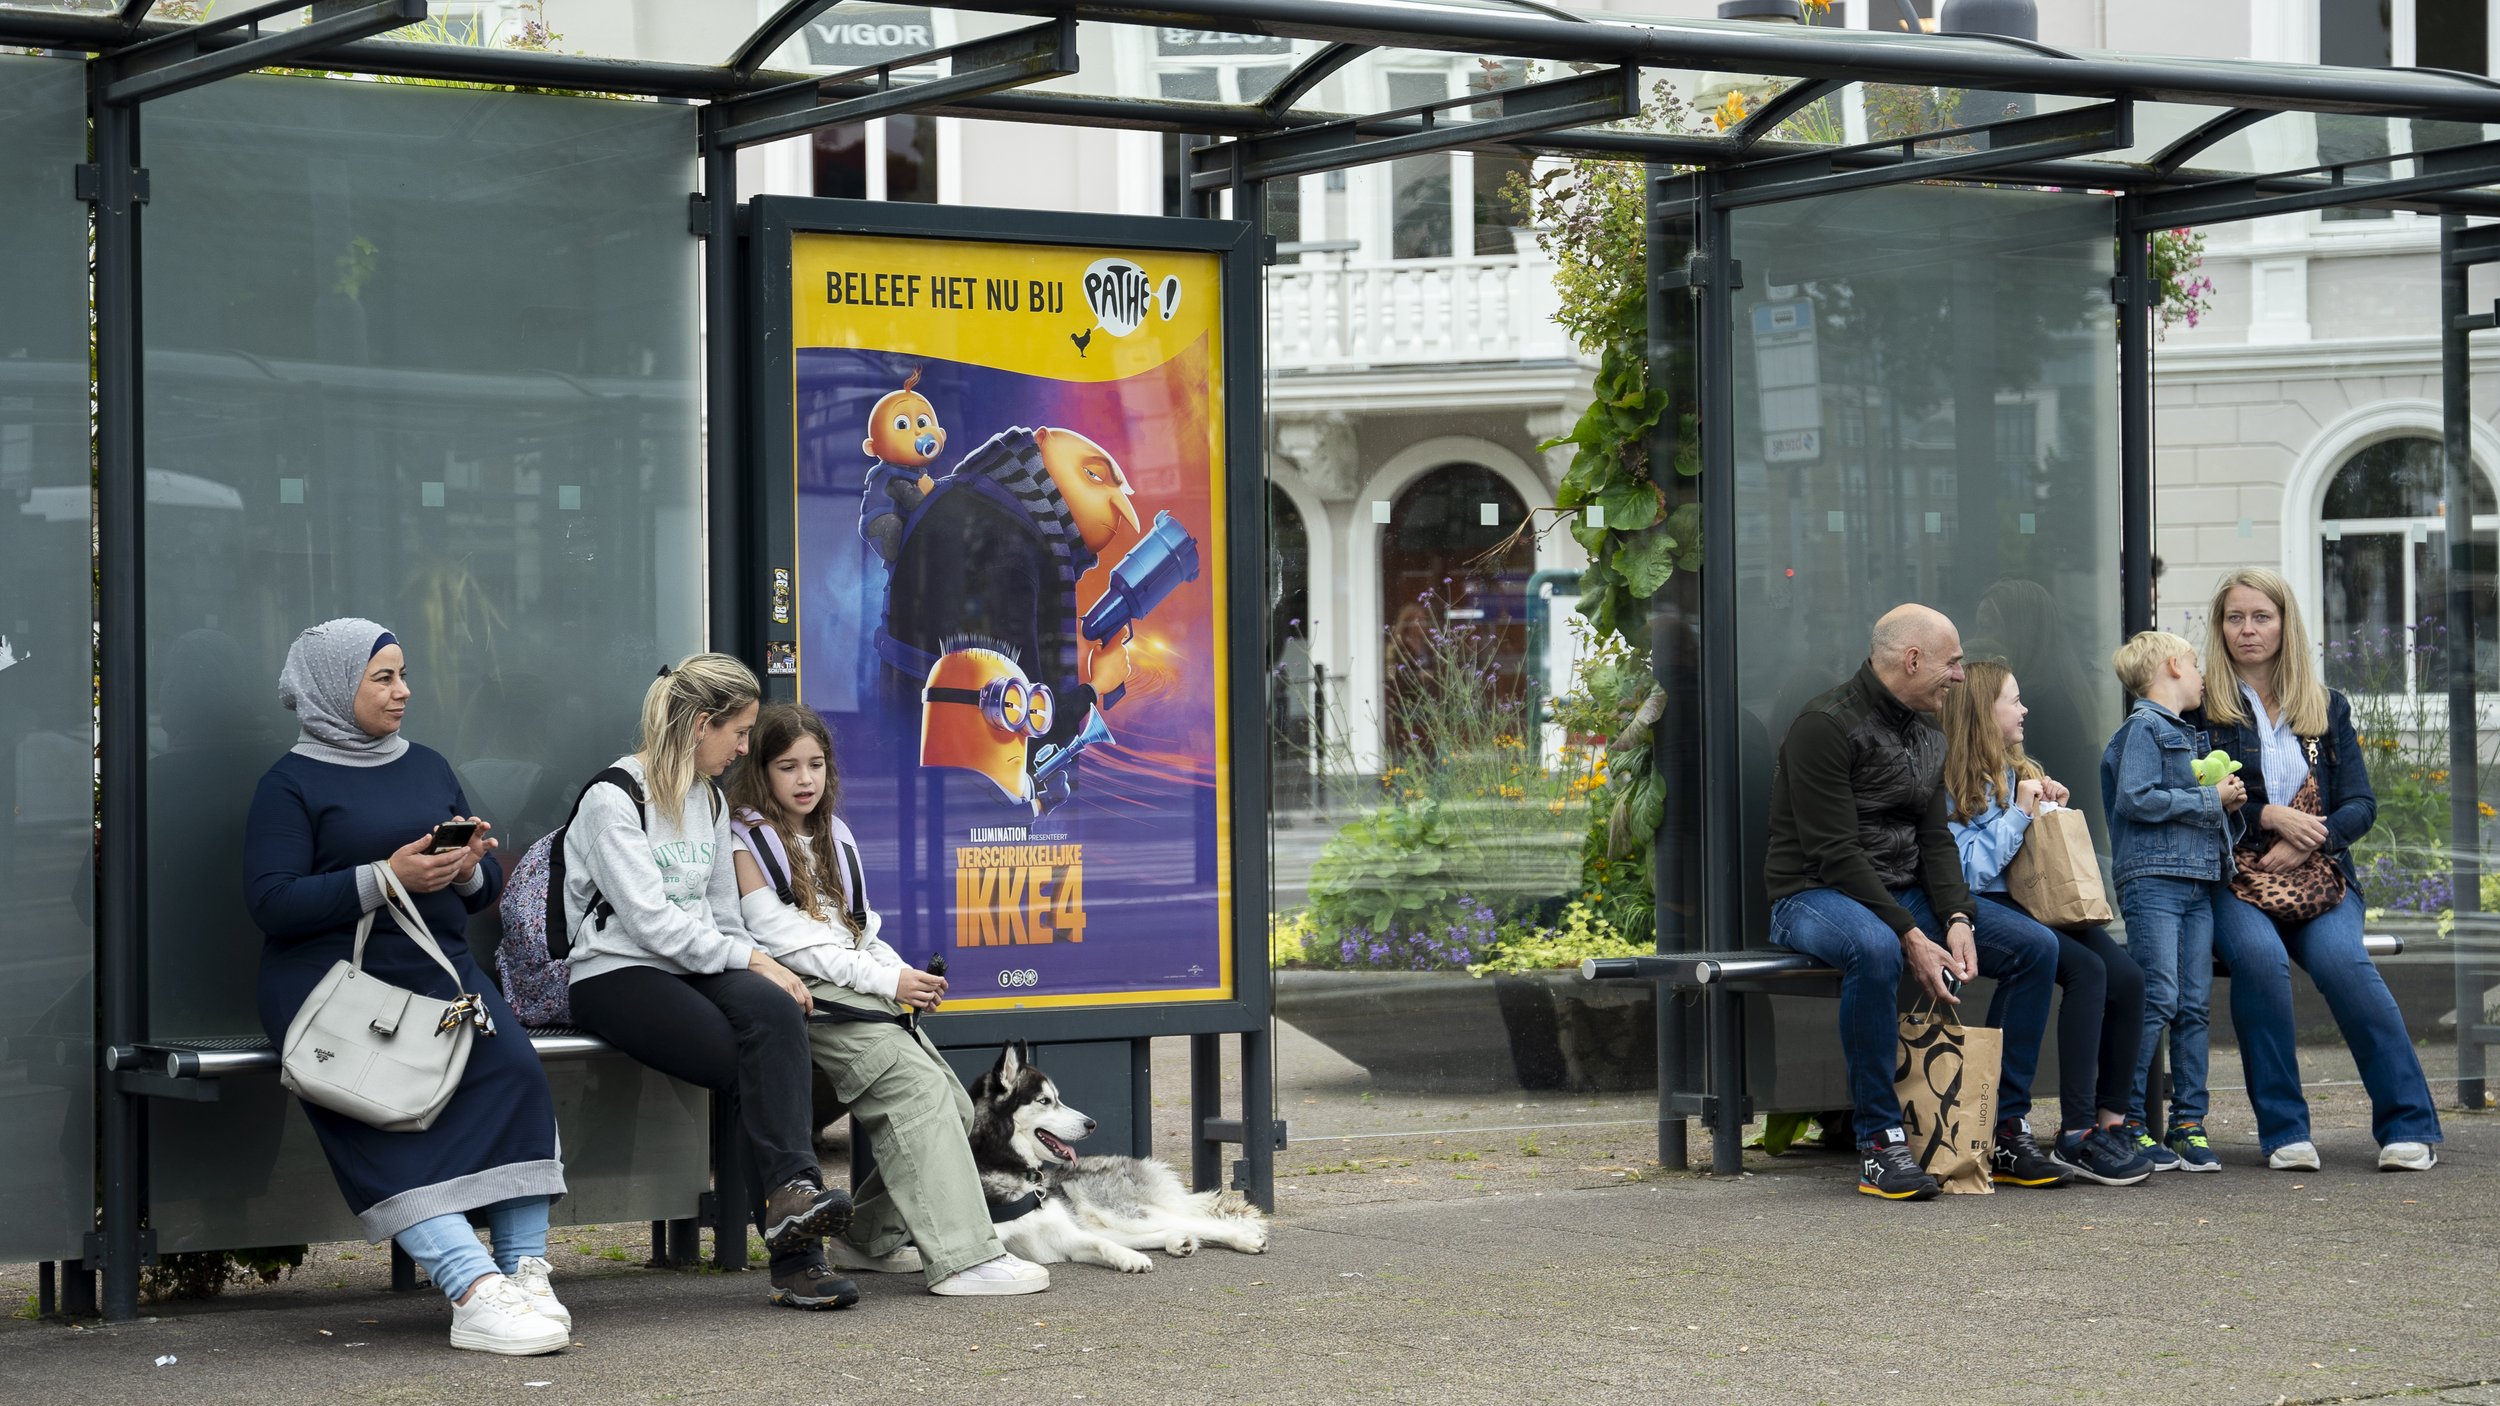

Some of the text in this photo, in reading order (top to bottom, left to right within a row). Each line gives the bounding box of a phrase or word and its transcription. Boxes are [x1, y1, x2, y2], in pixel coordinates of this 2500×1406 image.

[812, 23, 931, 46] VIGOR
[1198, 31, 1282, 43] ZE
[826, 271, 1064, 314] BELEEF HET NU BIJ
[970, 827, 1068, 843] ILLUMINATION PRESENTEERT
[956, 844, 1083, 868] VERSCHRIKKELIJKE
[1979, 1083, 1989, 1127] c-a.com
